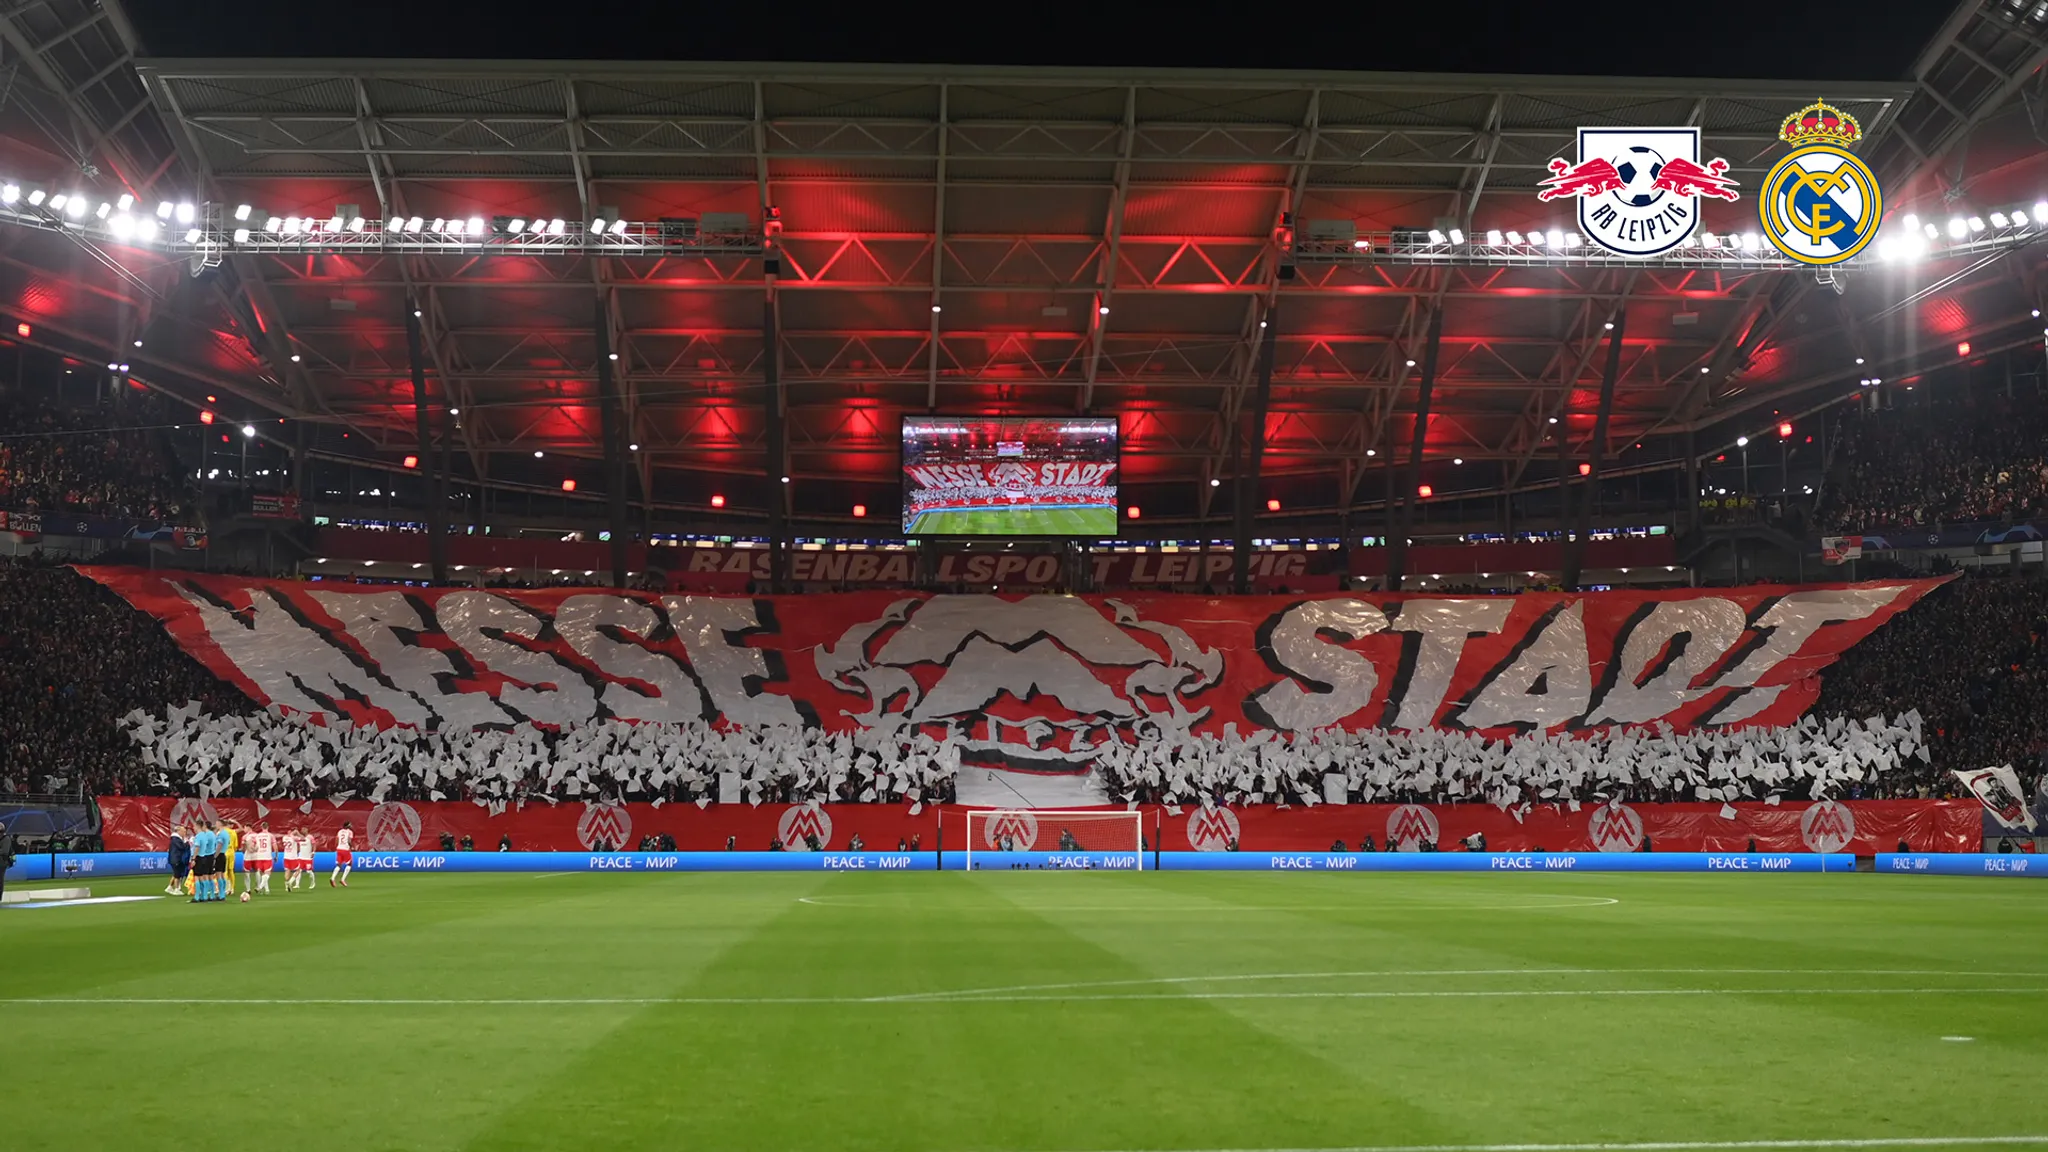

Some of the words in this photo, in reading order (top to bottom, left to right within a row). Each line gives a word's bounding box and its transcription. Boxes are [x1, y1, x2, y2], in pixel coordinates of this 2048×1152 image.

[912, 464, 988, 489] MESSE
[1040, 462, 1117, 485] STADT
[161, 577, 808, 732] MESSE
[1251, 582, 1904, 732] STADT
[357, 856, 399, 868] PEACE
[590, 856, 632, 868] PEACE
[823, 856, 865, 868] PEACE
[1048, 856, 1090, 868] PEACE
[1271, 856, 1312, 868] PEACE
[1491, 856, 1532, 868] PEACE
[1708, 857, 1748, 869] PEACE
[1893, 857, 1910, 869] PEACE
[1984, 859, 2005, 872] PEACE
